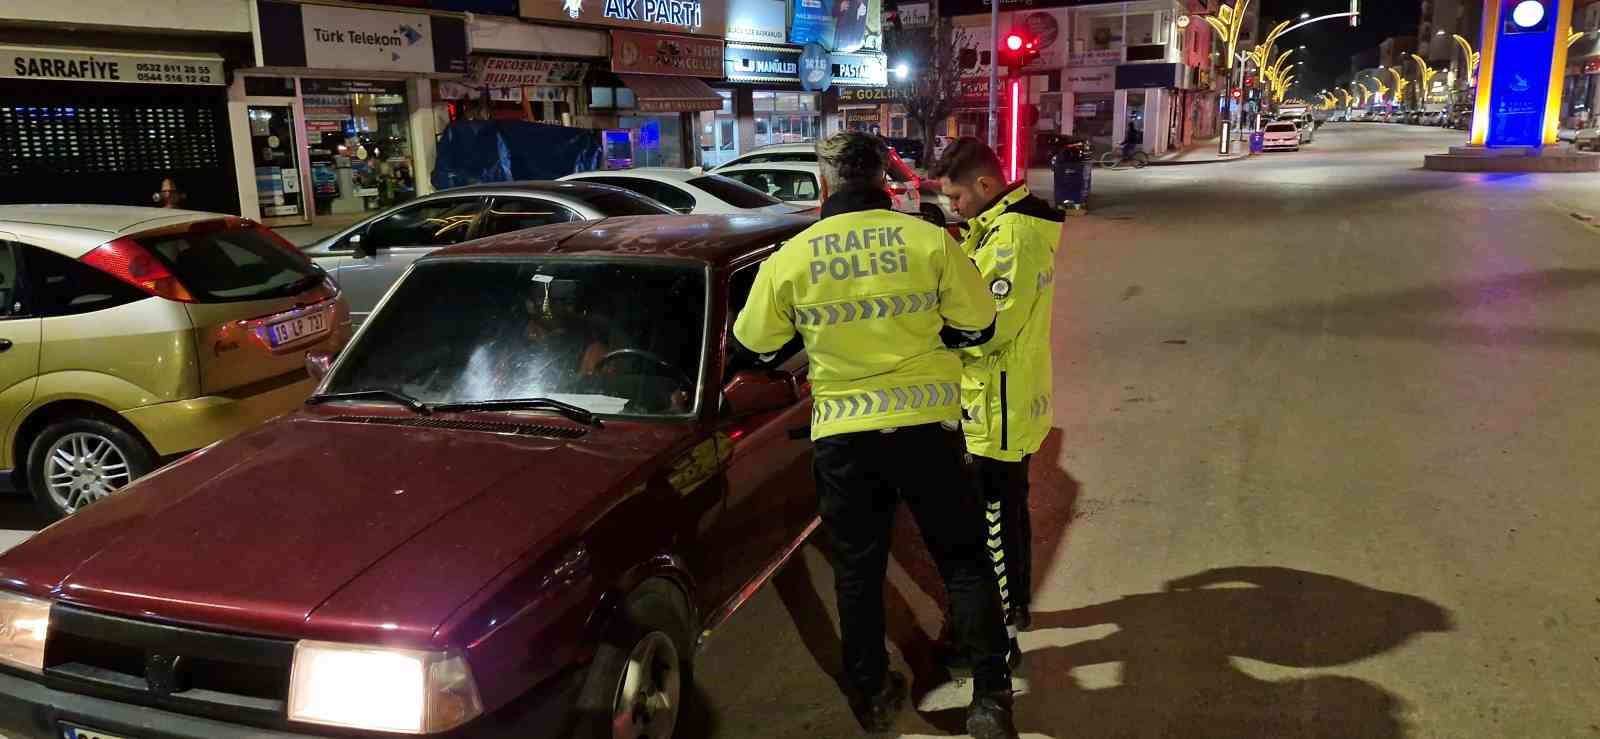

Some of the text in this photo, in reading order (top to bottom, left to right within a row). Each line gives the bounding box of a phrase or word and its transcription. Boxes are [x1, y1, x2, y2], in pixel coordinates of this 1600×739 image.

[605, 0, 637, 20] AK
[313, 28, 401, 46] Türk Telekom
[14, 56, 120, 81] SARRAFİYE
[275, 324, 288, 342] 19
[291, 319, 304, 337] LP
